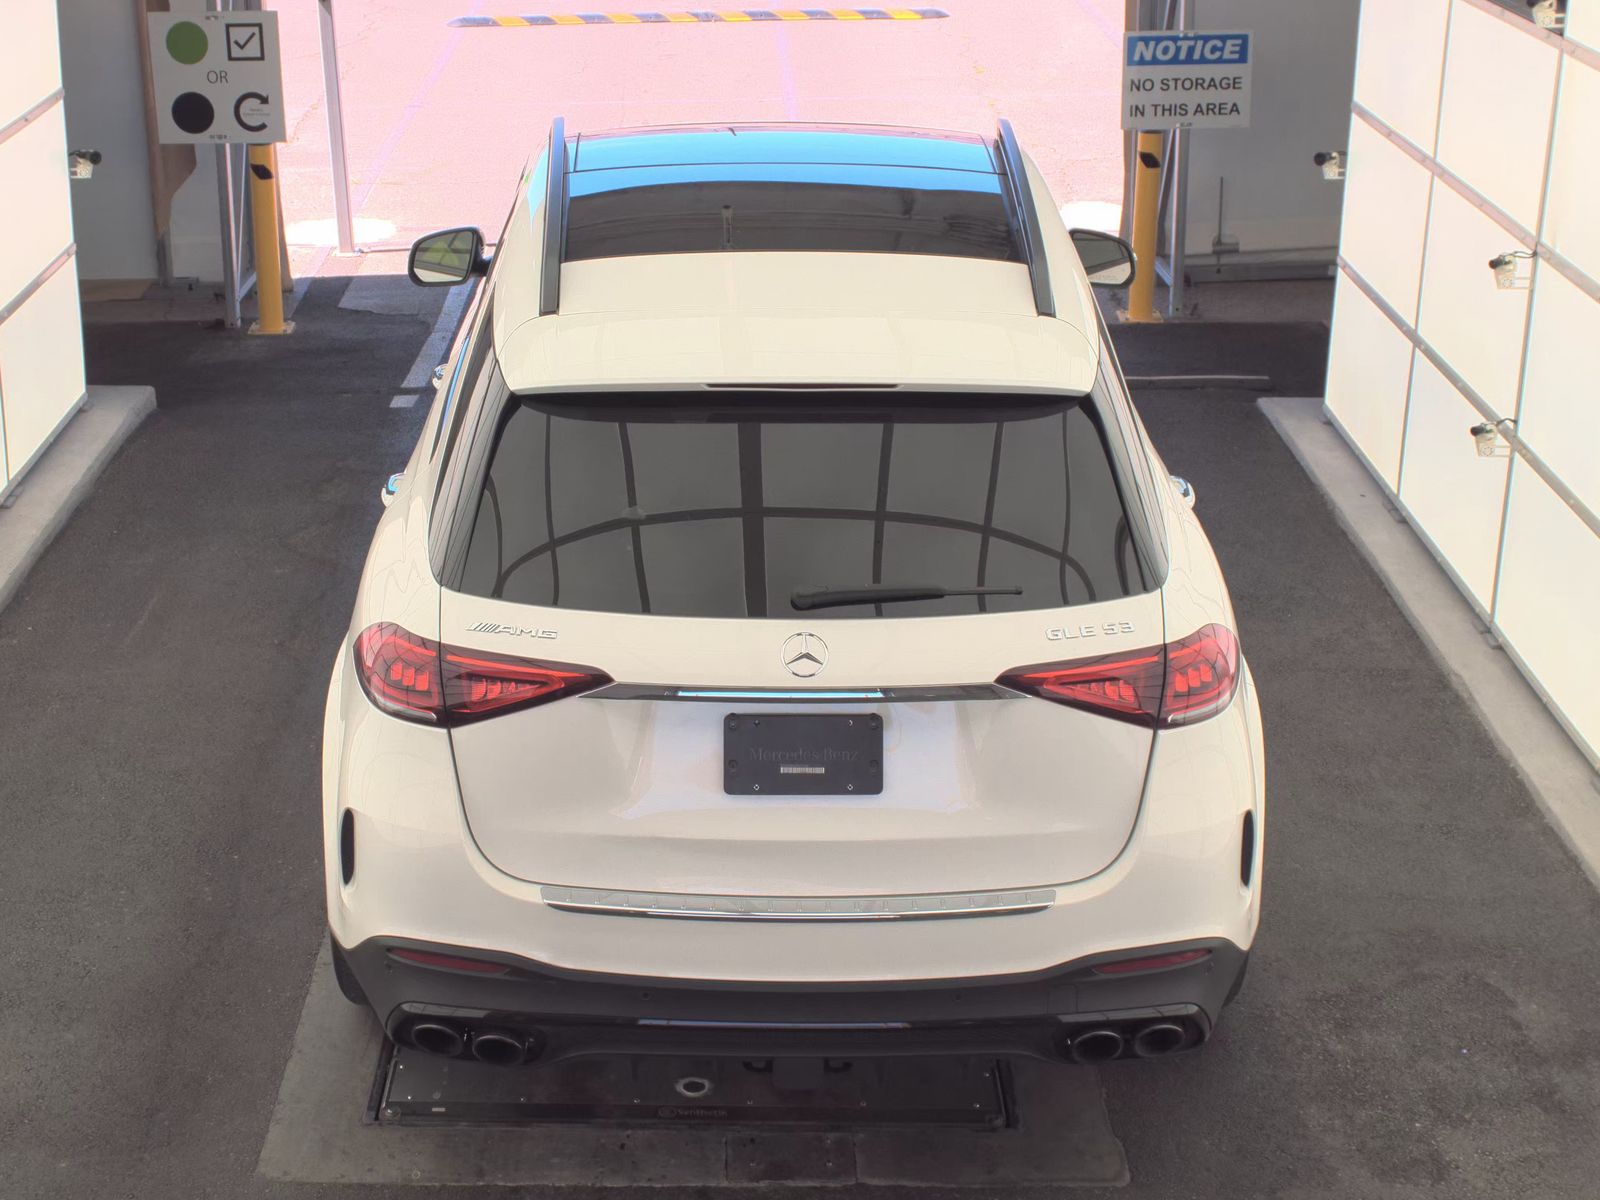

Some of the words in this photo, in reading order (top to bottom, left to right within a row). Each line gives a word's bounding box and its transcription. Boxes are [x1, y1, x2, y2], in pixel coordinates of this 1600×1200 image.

[1133, 39, 1242, 61] NOTICE
[206, 70, 229, 84] OR
[1130, 79, 1155, 92] NO
[1160, 76, 1243, 91] STORAGE
[1130, 104, 1145, 117] IN
[1151, 103, 1189, 117] THIS
[1193, 102, 1240, 116] AREA
[1045, 626, 1097, 641] GLE
[1102, 621, 1135, 635] 53
[750, 748, 858, 761] MercedesBenz
